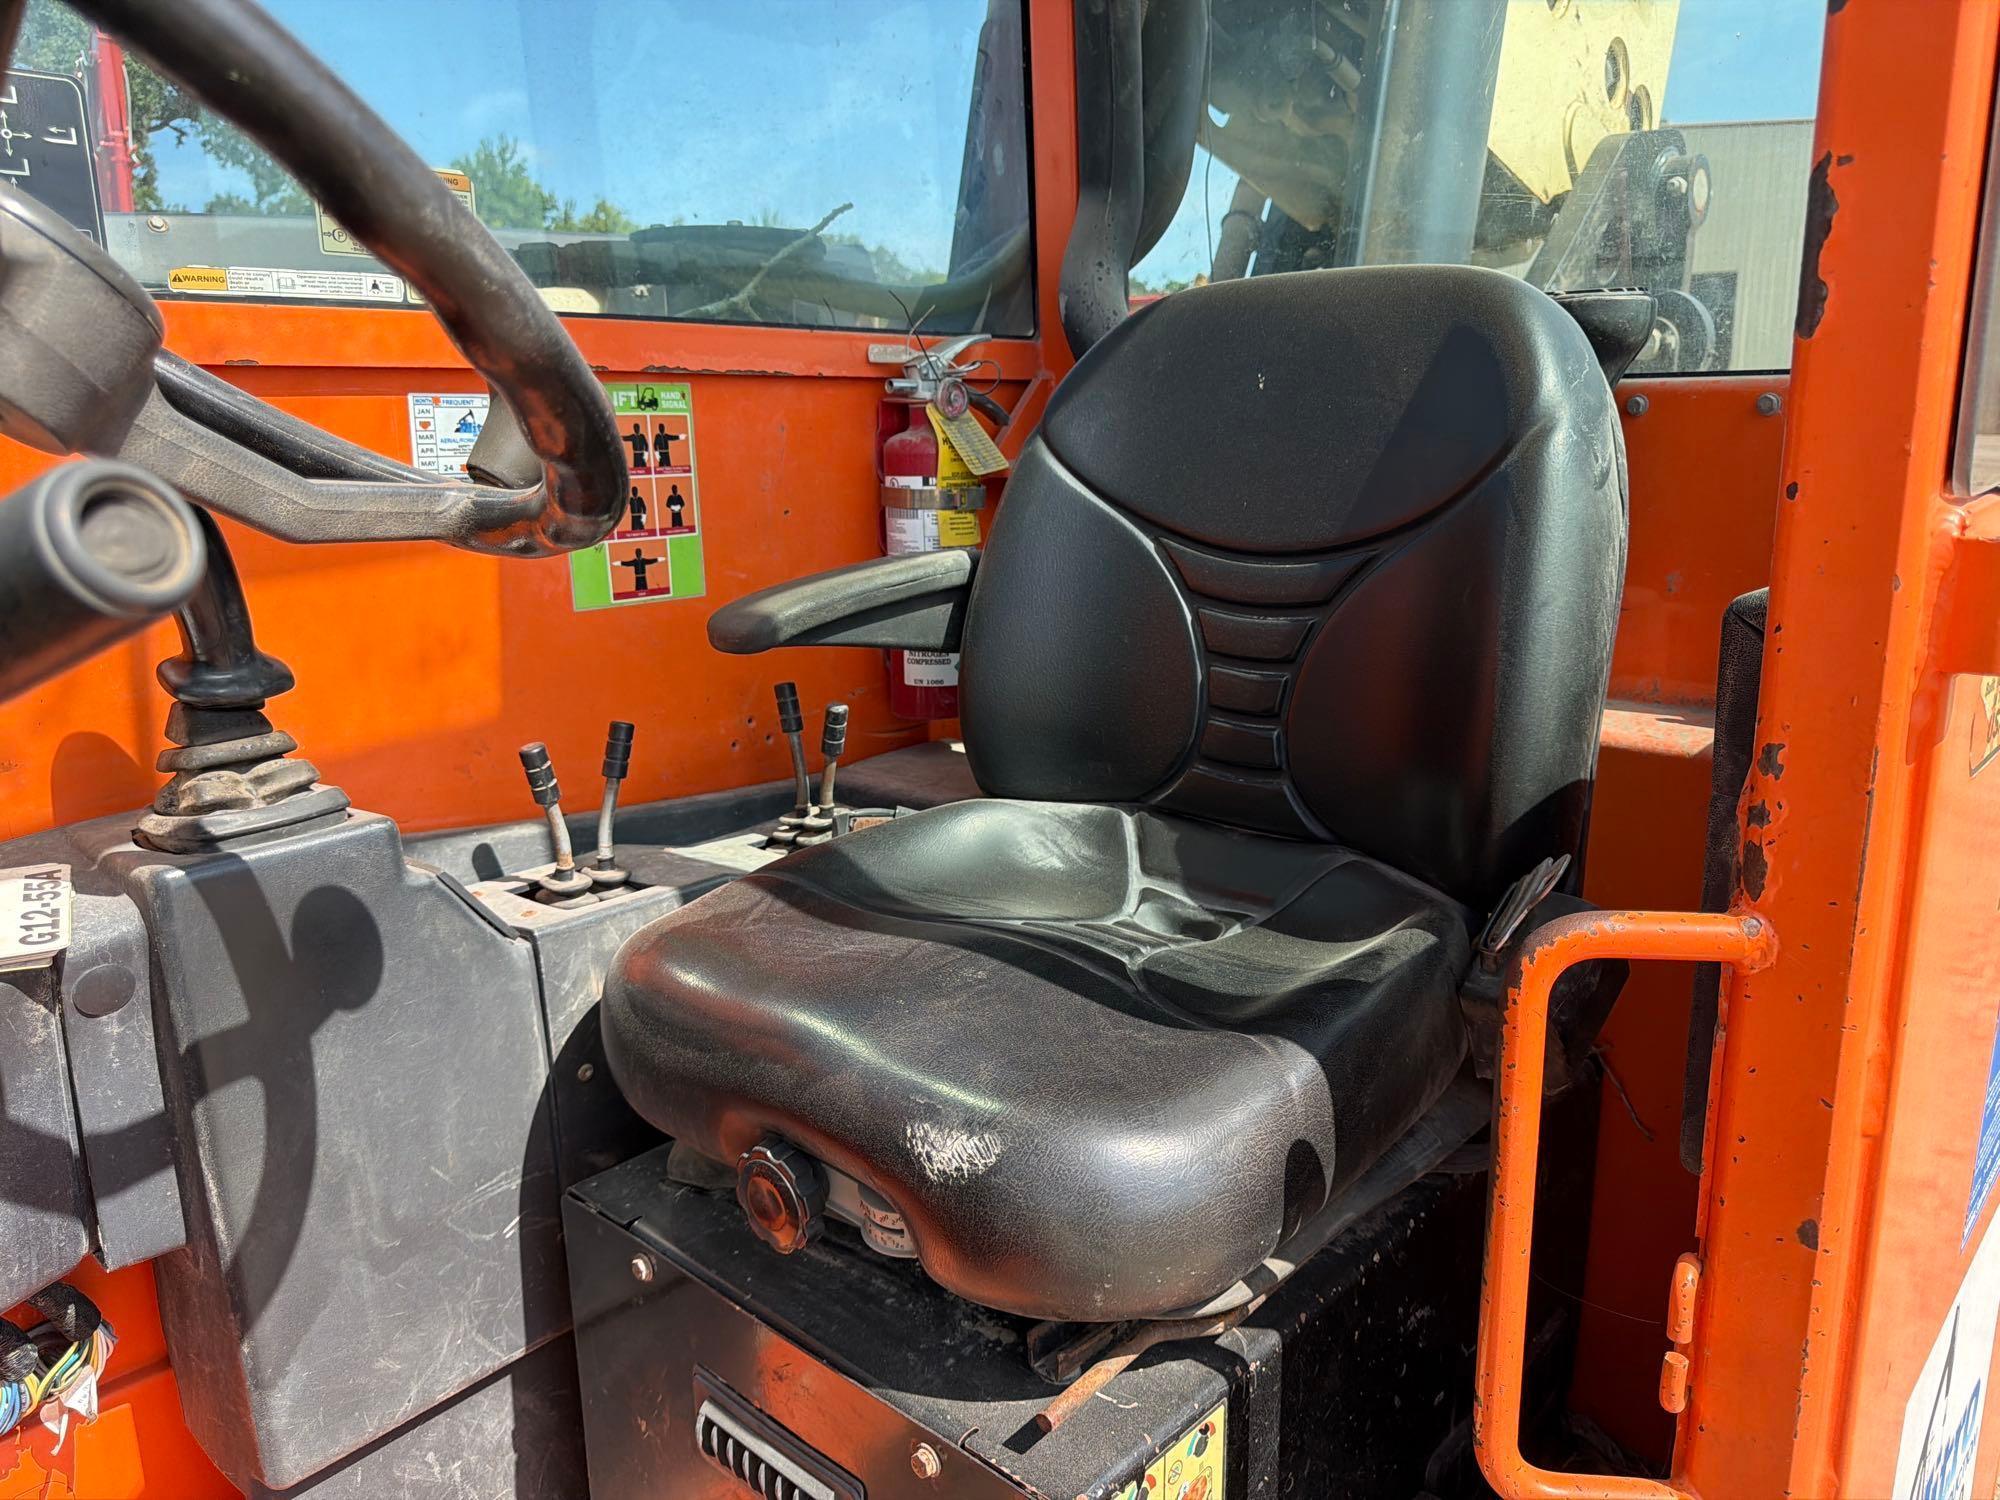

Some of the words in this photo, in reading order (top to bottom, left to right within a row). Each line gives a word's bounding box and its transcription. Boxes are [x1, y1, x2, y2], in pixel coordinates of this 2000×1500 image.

[182, 275, 225, 283] WARNING
[612, 391, 637, 407] IFT
[661, 391, 680, 400] HAND
[661, 400, 687, 408] SIGNAL
[443, 464, 454, 472] 24
[19, 869, 62, 945] G12-55A
